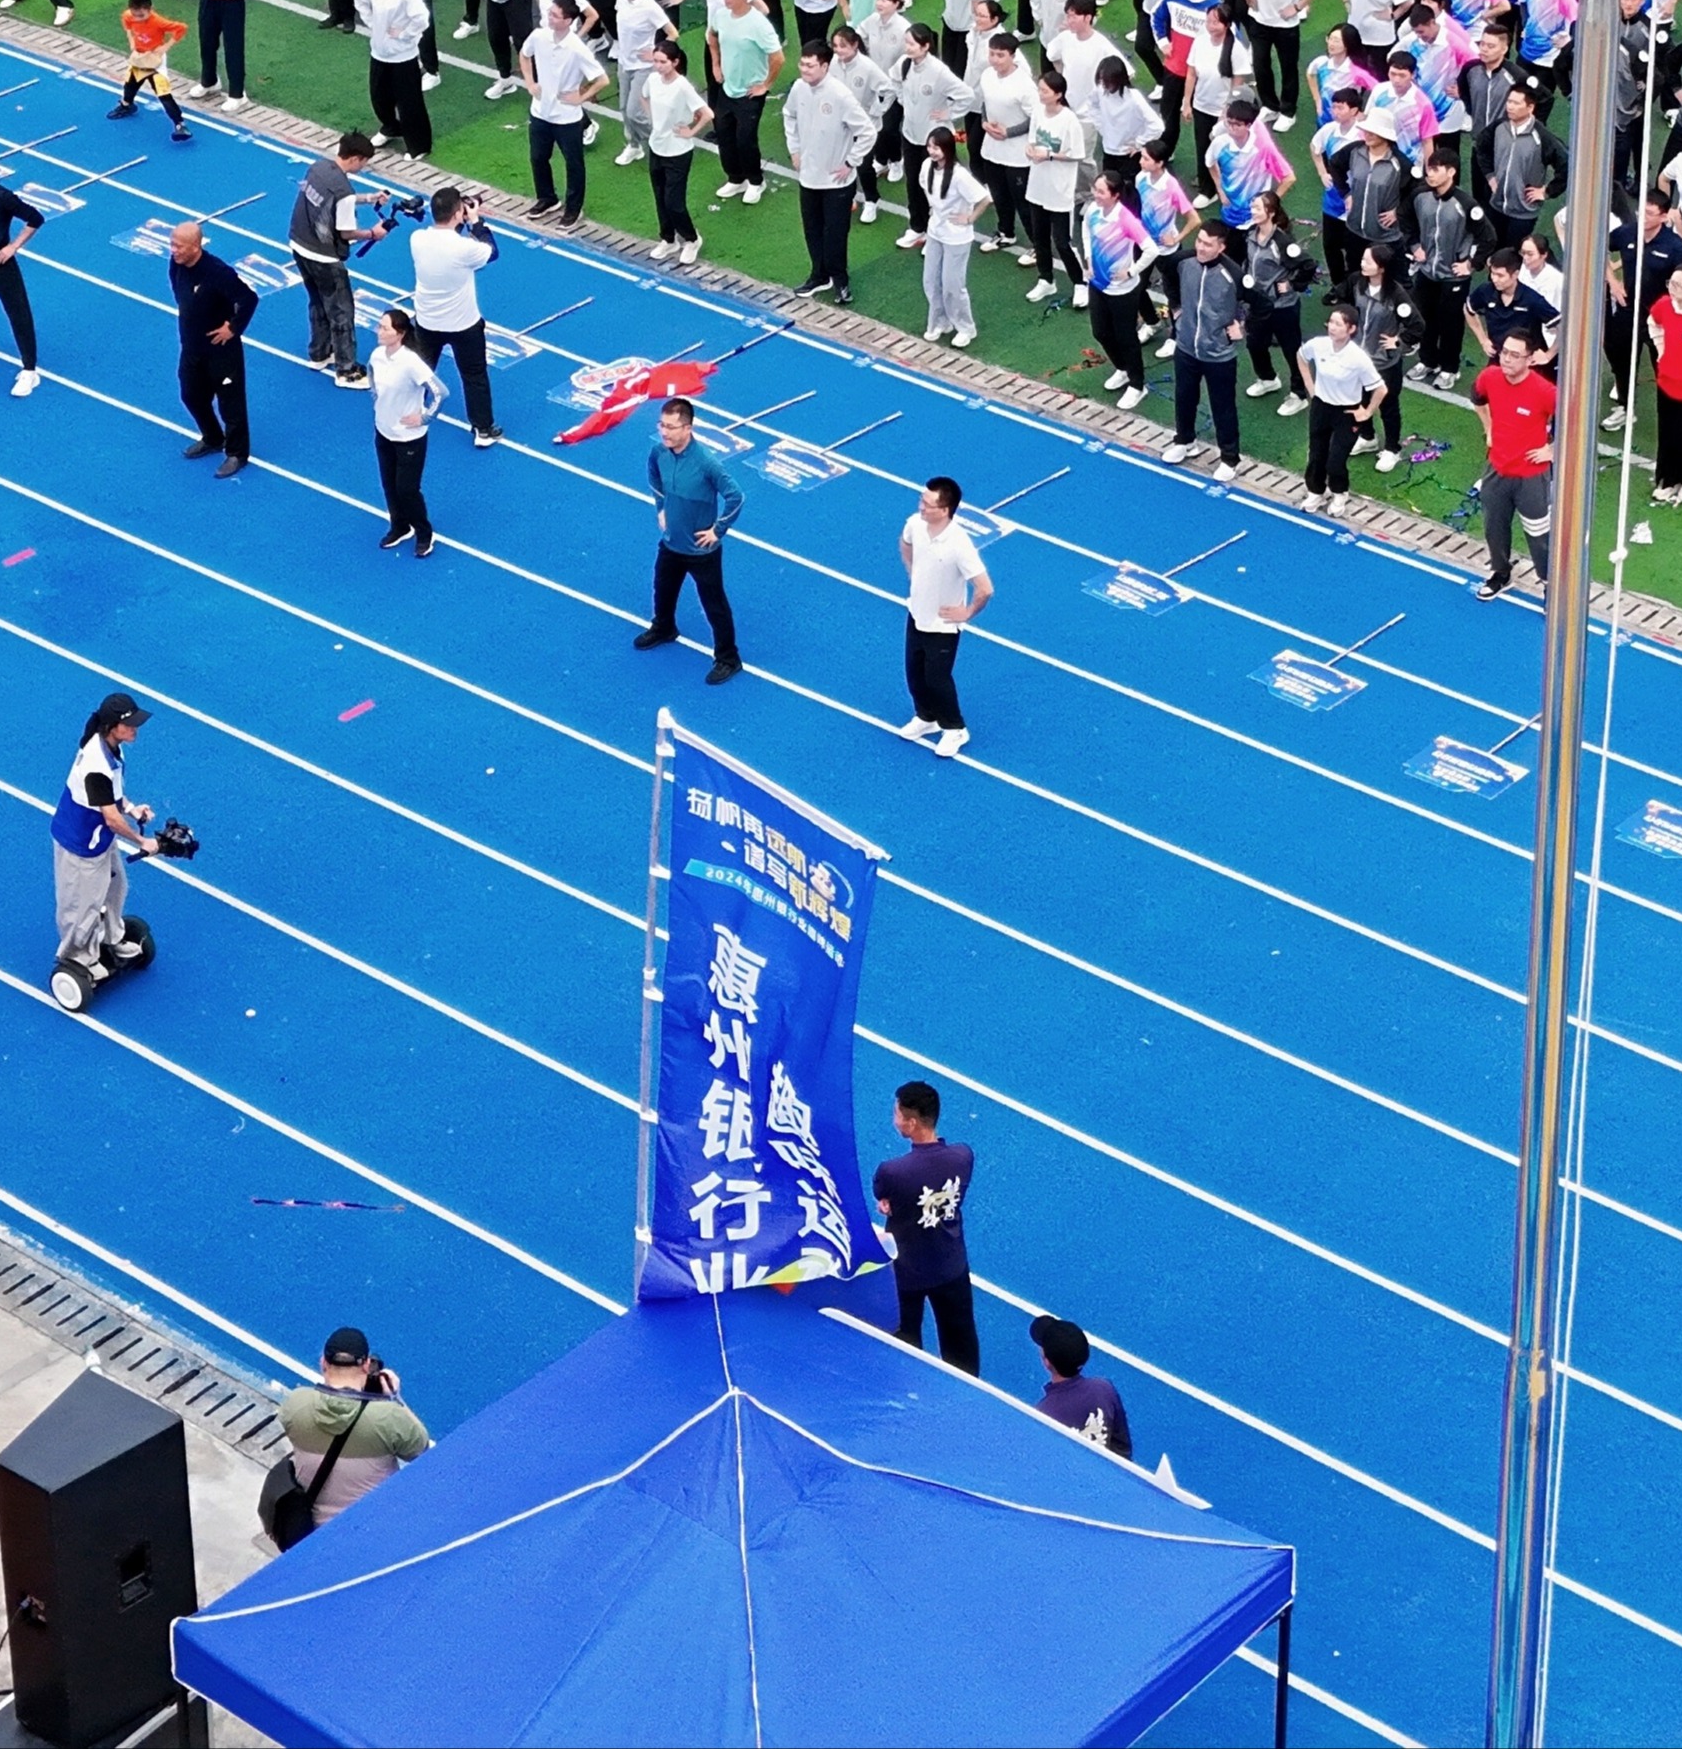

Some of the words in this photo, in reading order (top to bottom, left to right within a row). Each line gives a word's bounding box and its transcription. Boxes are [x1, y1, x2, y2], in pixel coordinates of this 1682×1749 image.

[686, 787, 807, 878] 扬帆再远航
[744, 837, 852, 944] 谱写新辉煌
